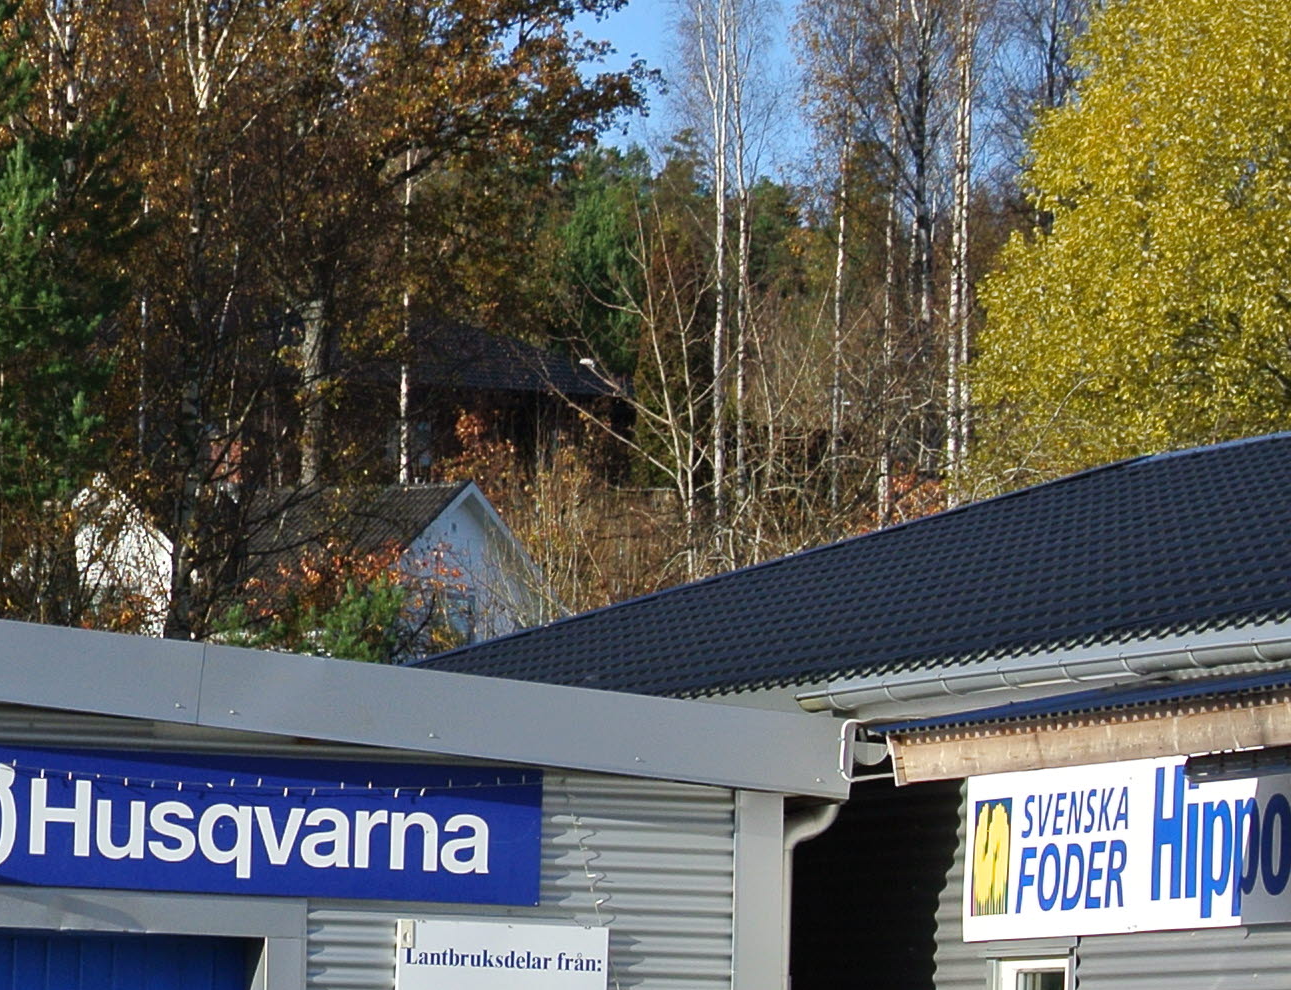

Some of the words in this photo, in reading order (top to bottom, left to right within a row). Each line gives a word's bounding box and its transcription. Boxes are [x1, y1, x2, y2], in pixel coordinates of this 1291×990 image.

[29, 777, 489, 879] Husqvarna
[1021, 785, 1129, 839] SVENSKA
[1015, 838, 1128, 915] FODER
[404, 947, 552, 971] Lantbruksdelar
[557, 951, 603, 973] från:
